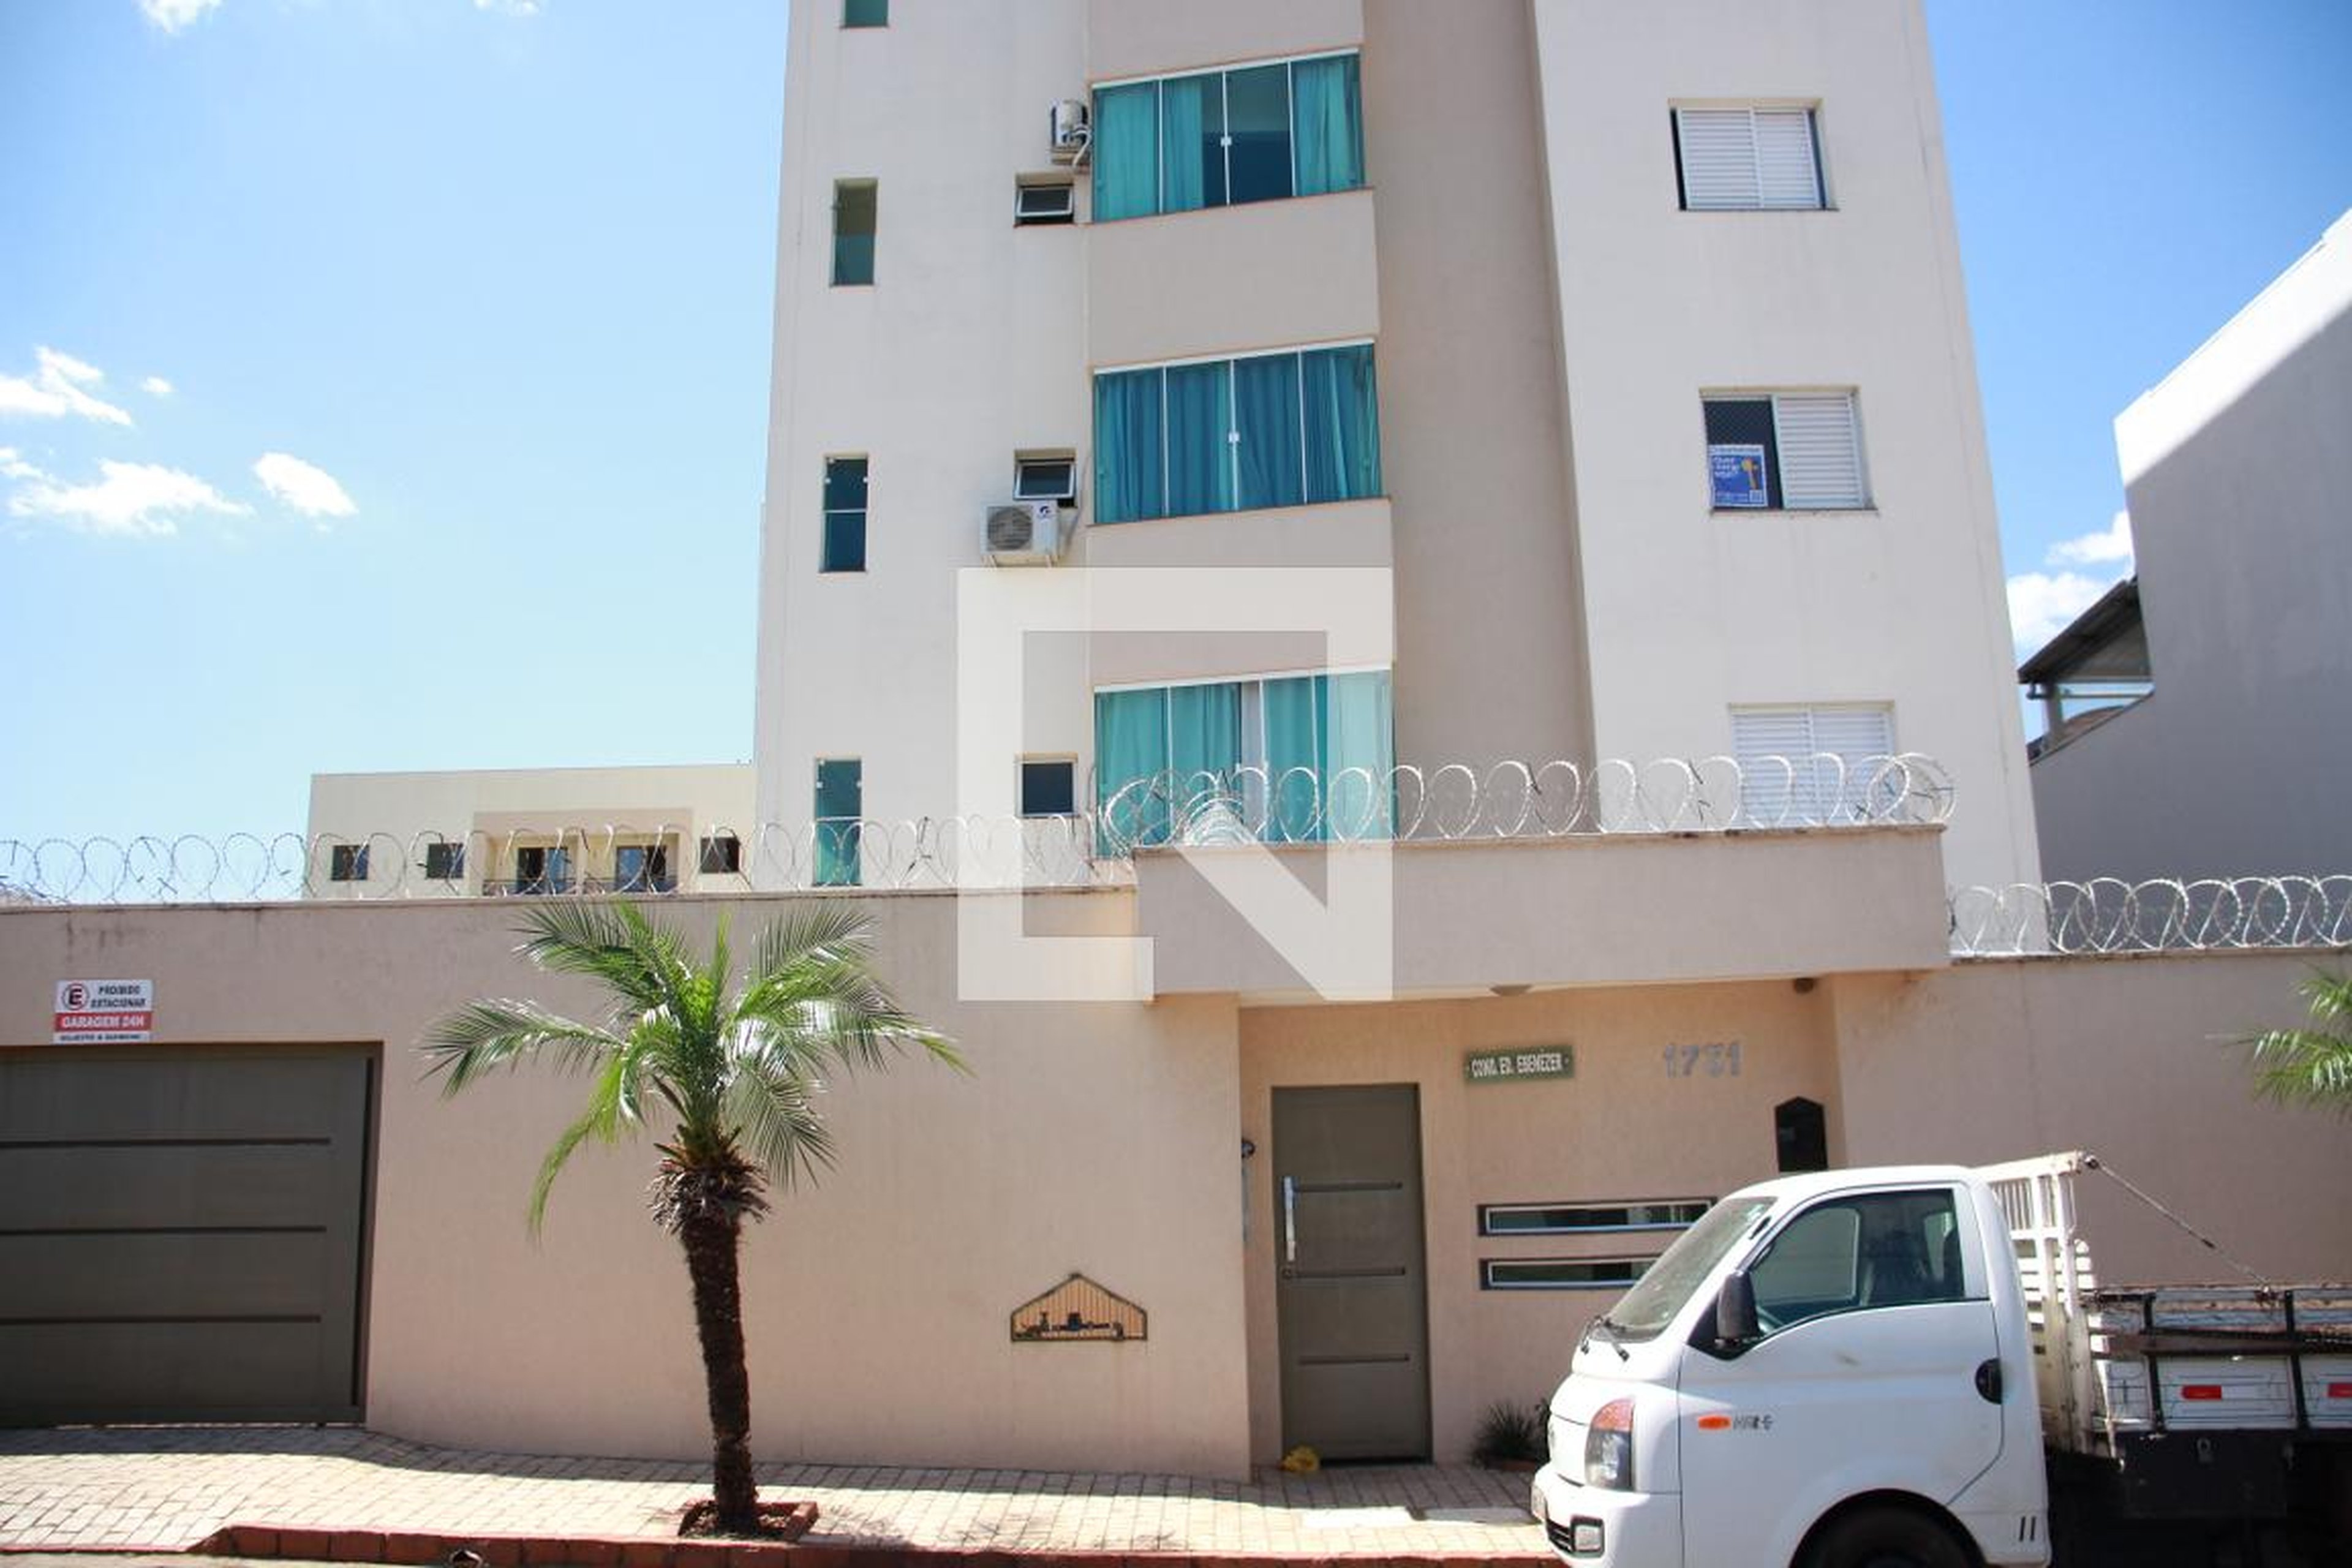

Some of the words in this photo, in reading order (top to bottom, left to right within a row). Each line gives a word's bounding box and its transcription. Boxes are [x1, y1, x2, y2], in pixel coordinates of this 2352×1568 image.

[98, 985, 141, 995] PROIBIDO
[69, 988, 83, 1005] E
[91, 998, 146, 1008] ESTACIONAR
[63, 1016, 119, 1028] GARAGEM
